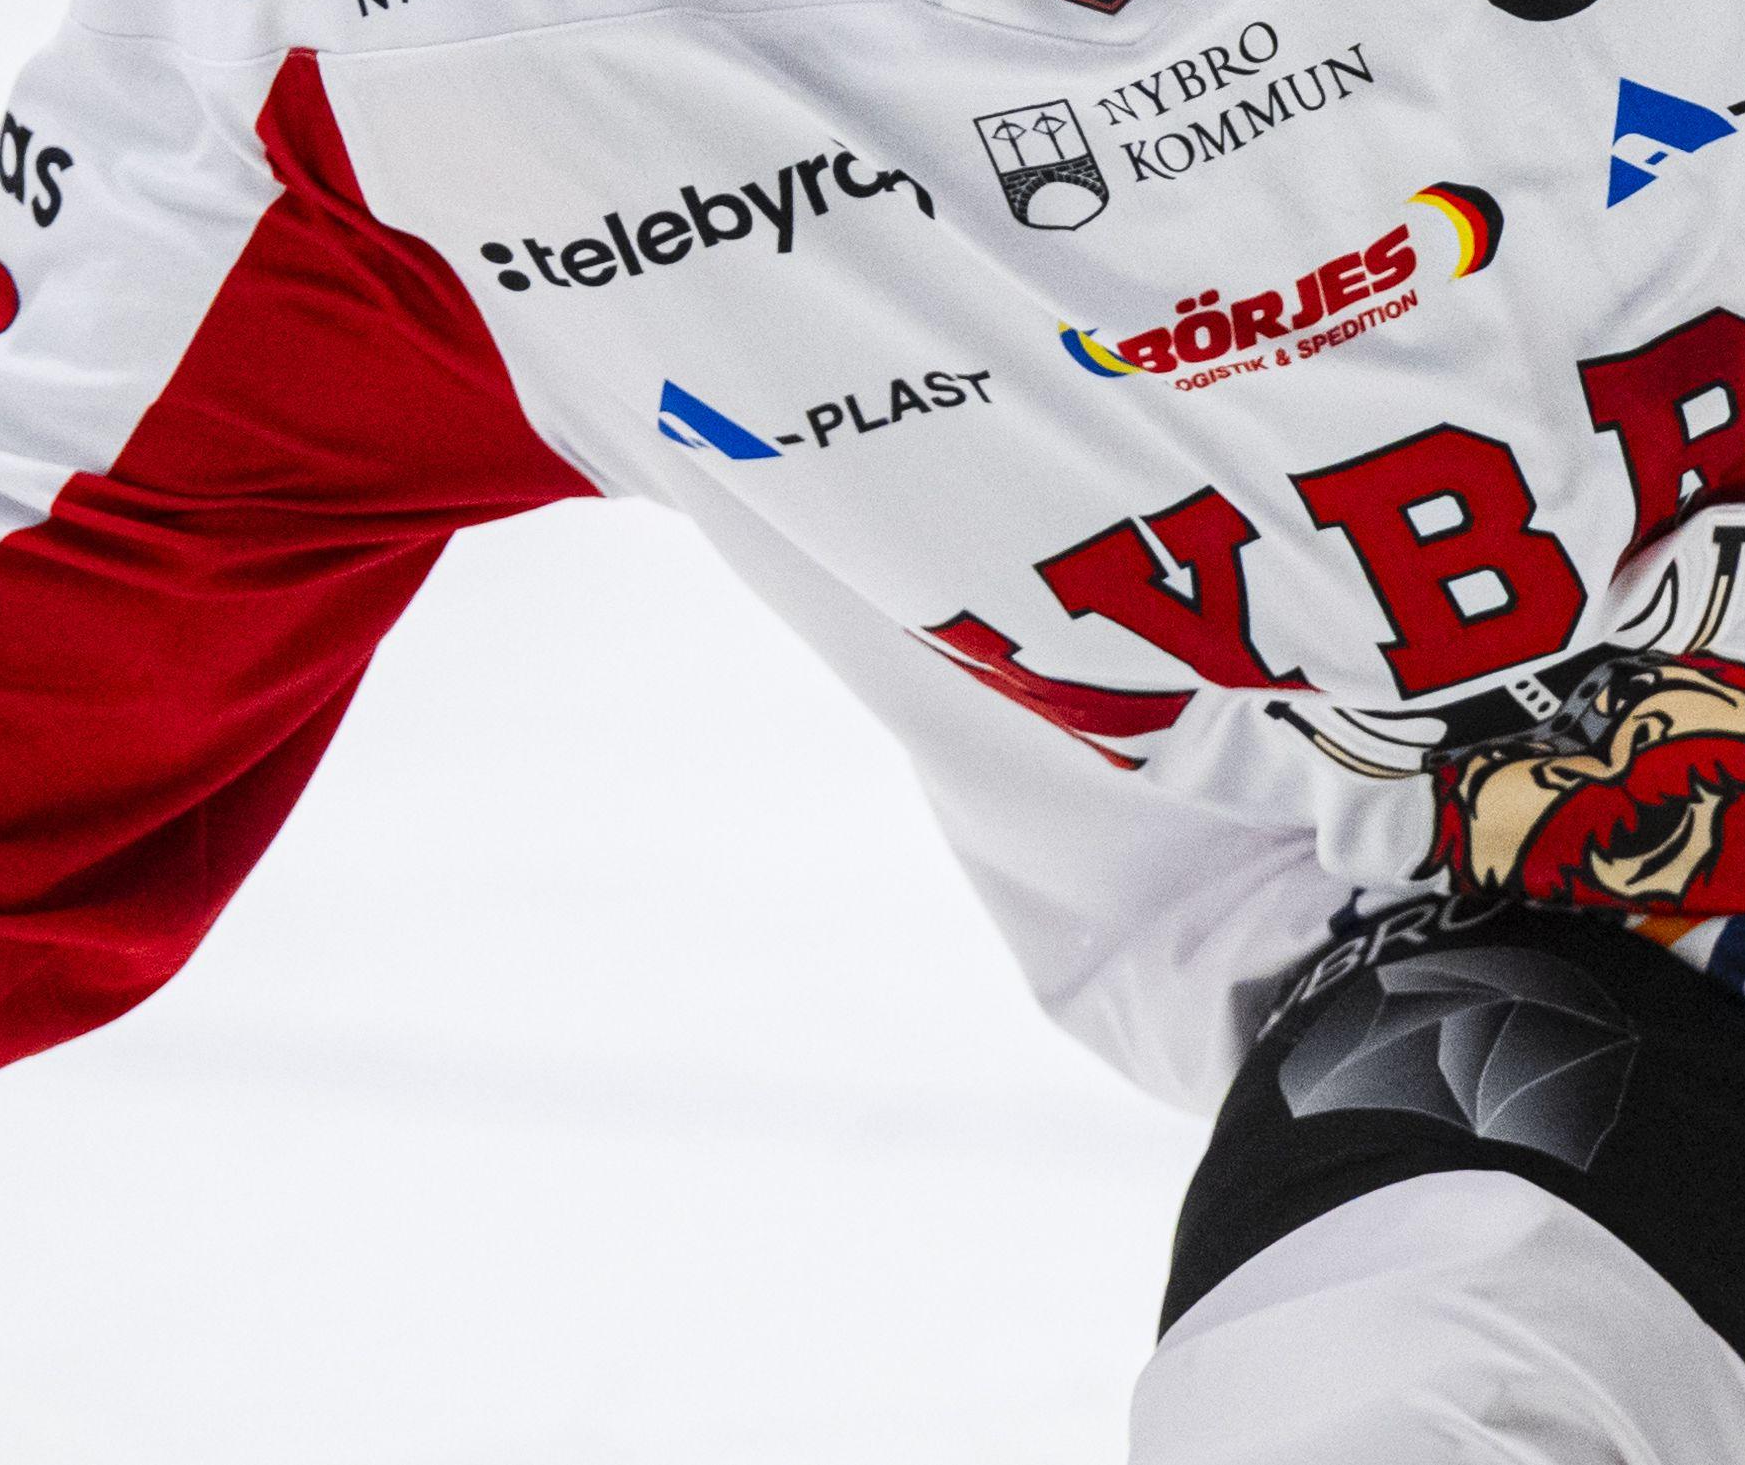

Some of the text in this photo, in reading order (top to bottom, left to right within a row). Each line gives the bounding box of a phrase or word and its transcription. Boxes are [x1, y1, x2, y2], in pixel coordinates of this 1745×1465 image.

[1095, 21, 1279, 126] NYBRO
[1120, 42, 1375, 183] KOMMUN
[1116, 224, 1417, 374] BÖRJES
[1173, 288, 1419, 392] OGISTIK & SPEDITION
